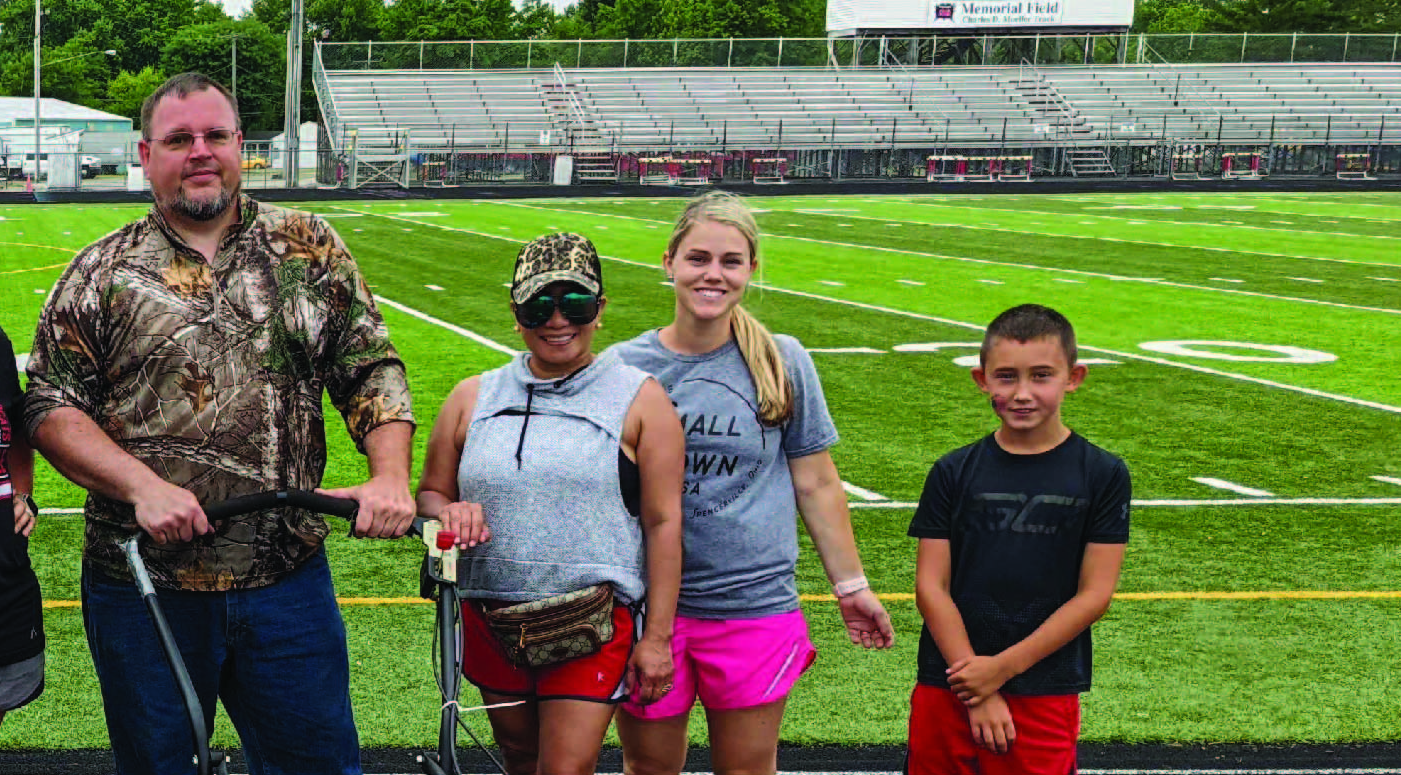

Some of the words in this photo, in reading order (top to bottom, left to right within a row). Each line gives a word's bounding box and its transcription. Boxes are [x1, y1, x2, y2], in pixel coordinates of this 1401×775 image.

[962, 2, 1022, 14] Memorial
[1027, 2, 1059, 14] Field
[681, 414, 741, 436] ALL
[681, 480, 700, 496] SA
